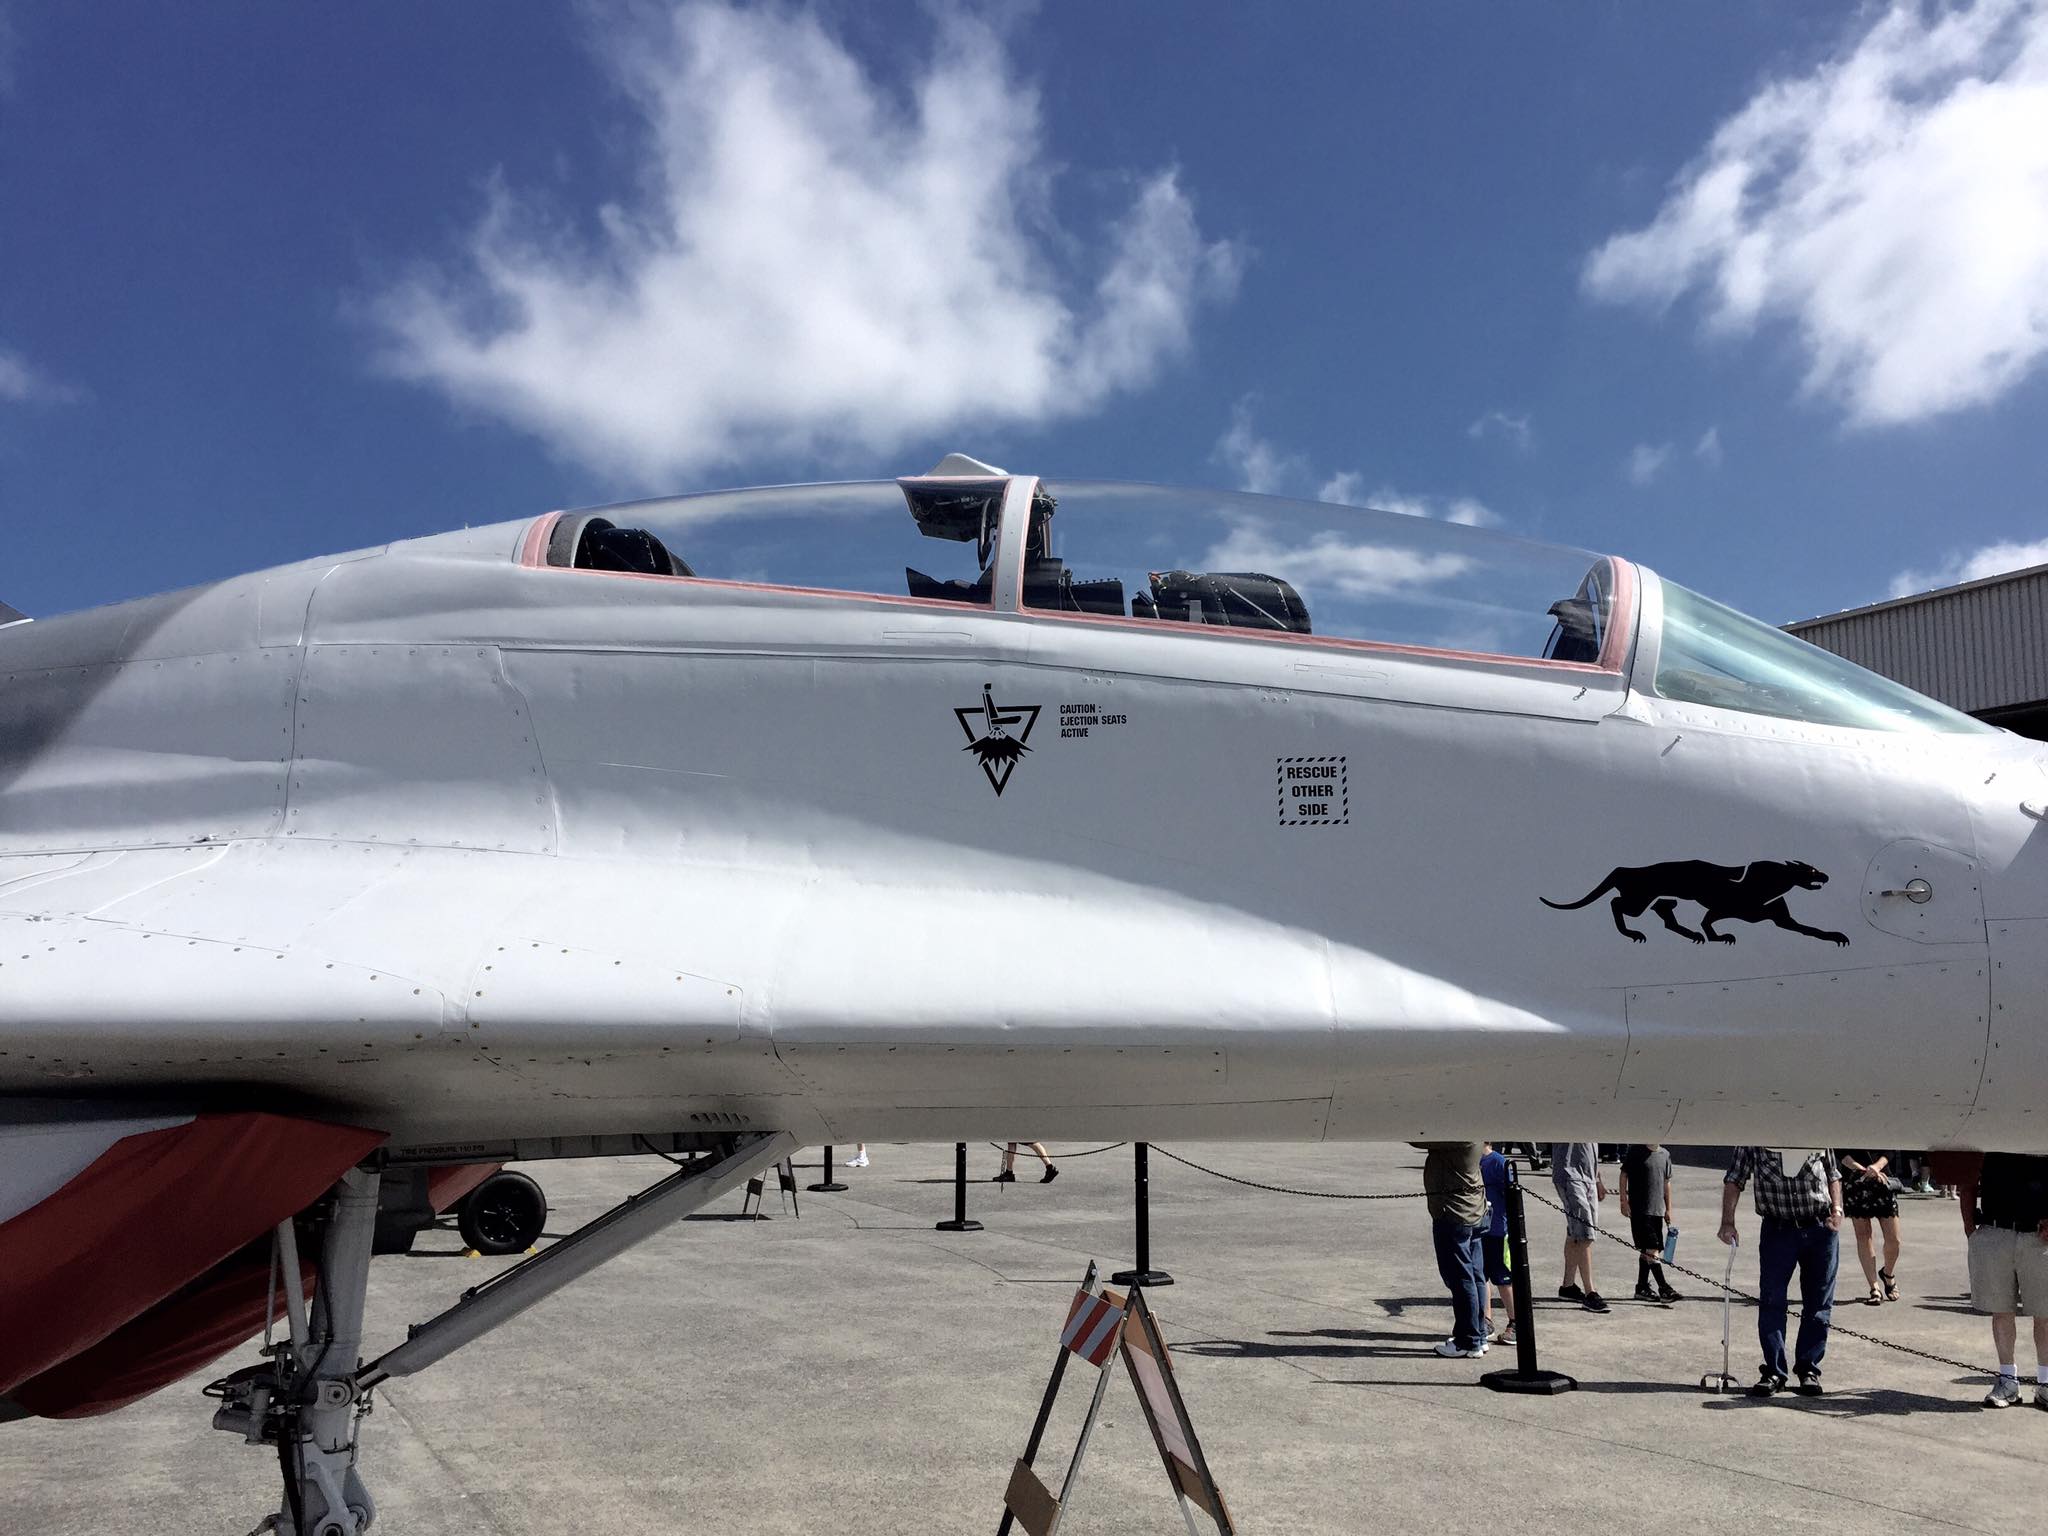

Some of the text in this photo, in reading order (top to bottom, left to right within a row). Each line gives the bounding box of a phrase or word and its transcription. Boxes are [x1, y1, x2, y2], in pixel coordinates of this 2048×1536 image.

[1060, 704, 1096, 714] CAUTION
[1060, 714, 1127, 726] EJECTION SEATS
[1060, 727, 1089, 738] ACTIVE
[1286, 766, 1337, 779] RESCUE
[1291, 784, 1334, 797] OTHER
[1298, 803, 1328, 816] SIDE
